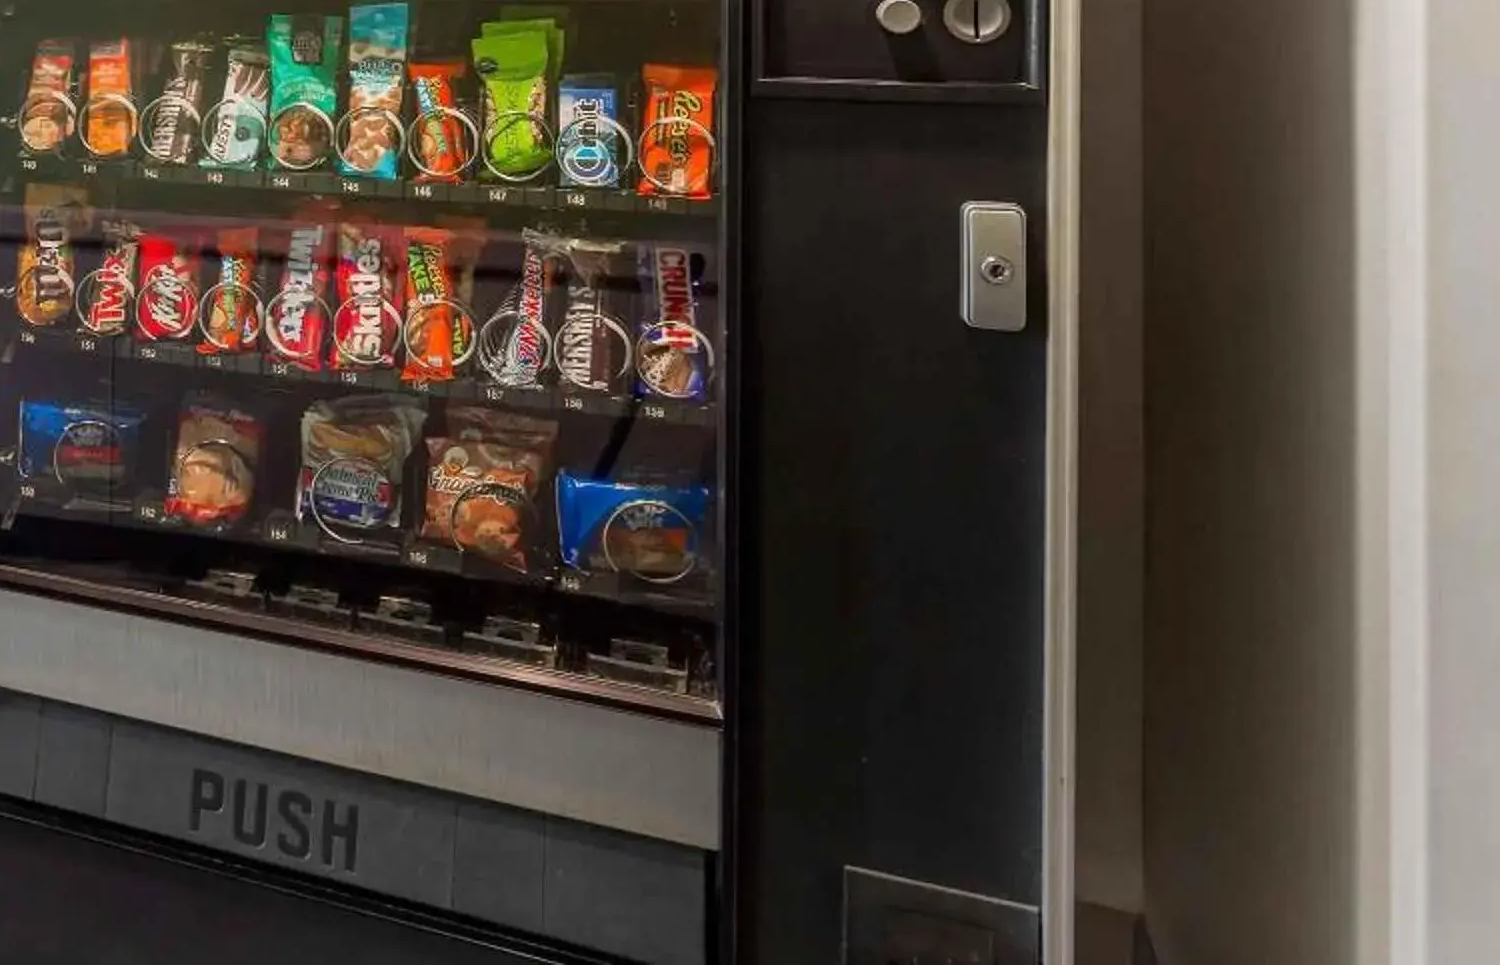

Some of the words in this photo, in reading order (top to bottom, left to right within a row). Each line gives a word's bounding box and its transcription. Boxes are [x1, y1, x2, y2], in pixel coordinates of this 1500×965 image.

[207, 174, 223, 183] 143
[342, 183, 359, 193] 145
[415, 186, 432, 197] 146
[489, 191, 506, 201] 147
[90, 251, 128, 324] Twix
[352, 238, 383, 358] Skittles
[564, 285, 596, 384] HERSHEY'S
[81, 340, 95, 351] 151
[487, 389, 504, 400] 157
[190, 767, 359, 873] PUSH
